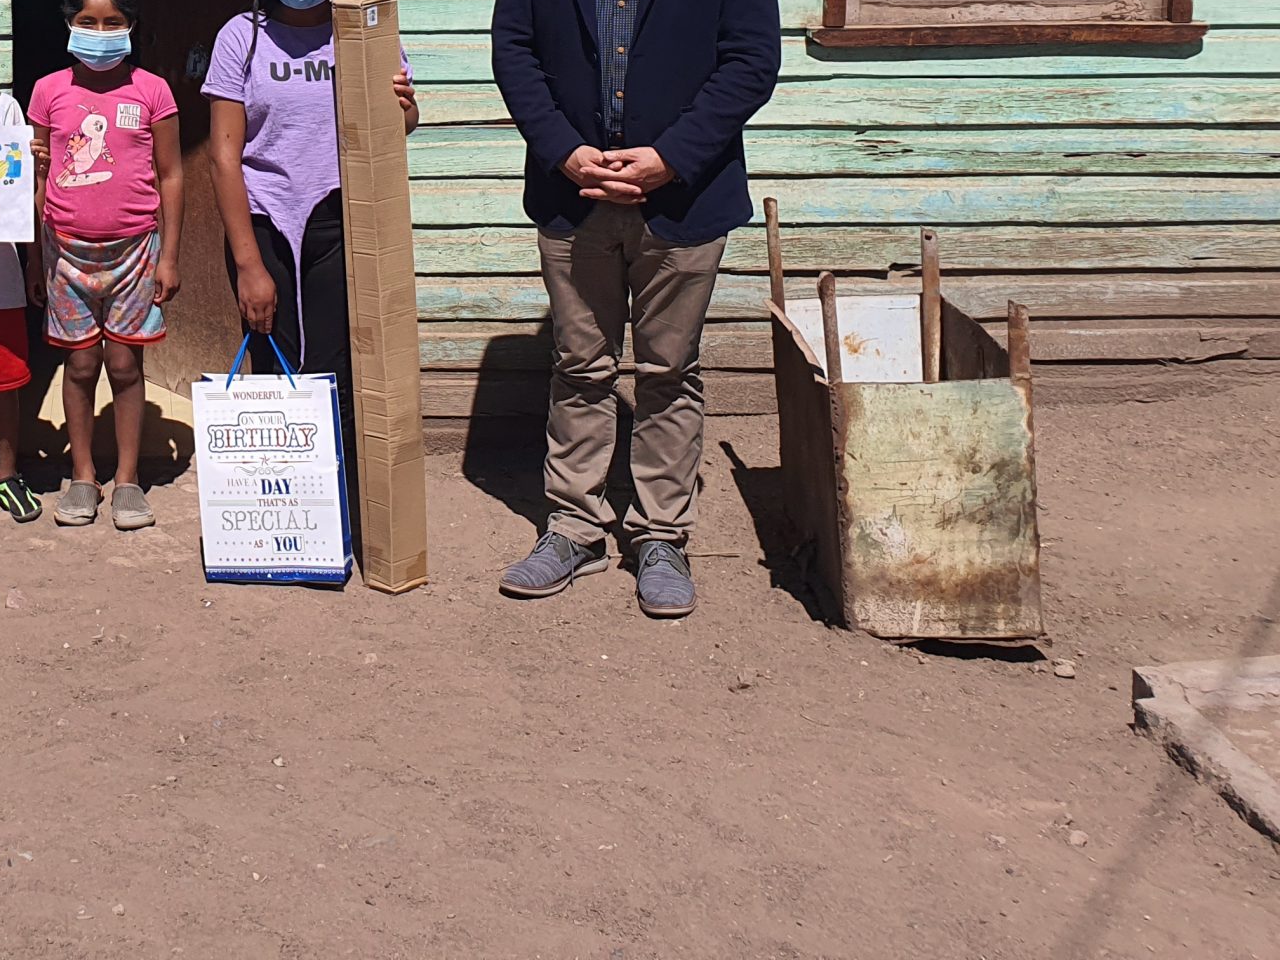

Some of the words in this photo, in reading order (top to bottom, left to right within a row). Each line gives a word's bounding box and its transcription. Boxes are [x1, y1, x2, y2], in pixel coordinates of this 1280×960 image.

[232, 391, 284, 400] WONDERFUL
[241, 415, 254, 425] ON
[258, 415, 282, 425] YOUR
[211, 428, 314, 449] BIRTHDAY
[227, 478, 249, 487] HAVE
[252, 478, 258, 487] A
[260, 478, 292, 495] DAY
[256, 498, 286, 507] THAT'S
[288, 498, 299, 507] AS
[221, 510, 318, 532] SPECIAL
[253, 539, 264, 548] AS
[272, 536, 303, 551] YOU
